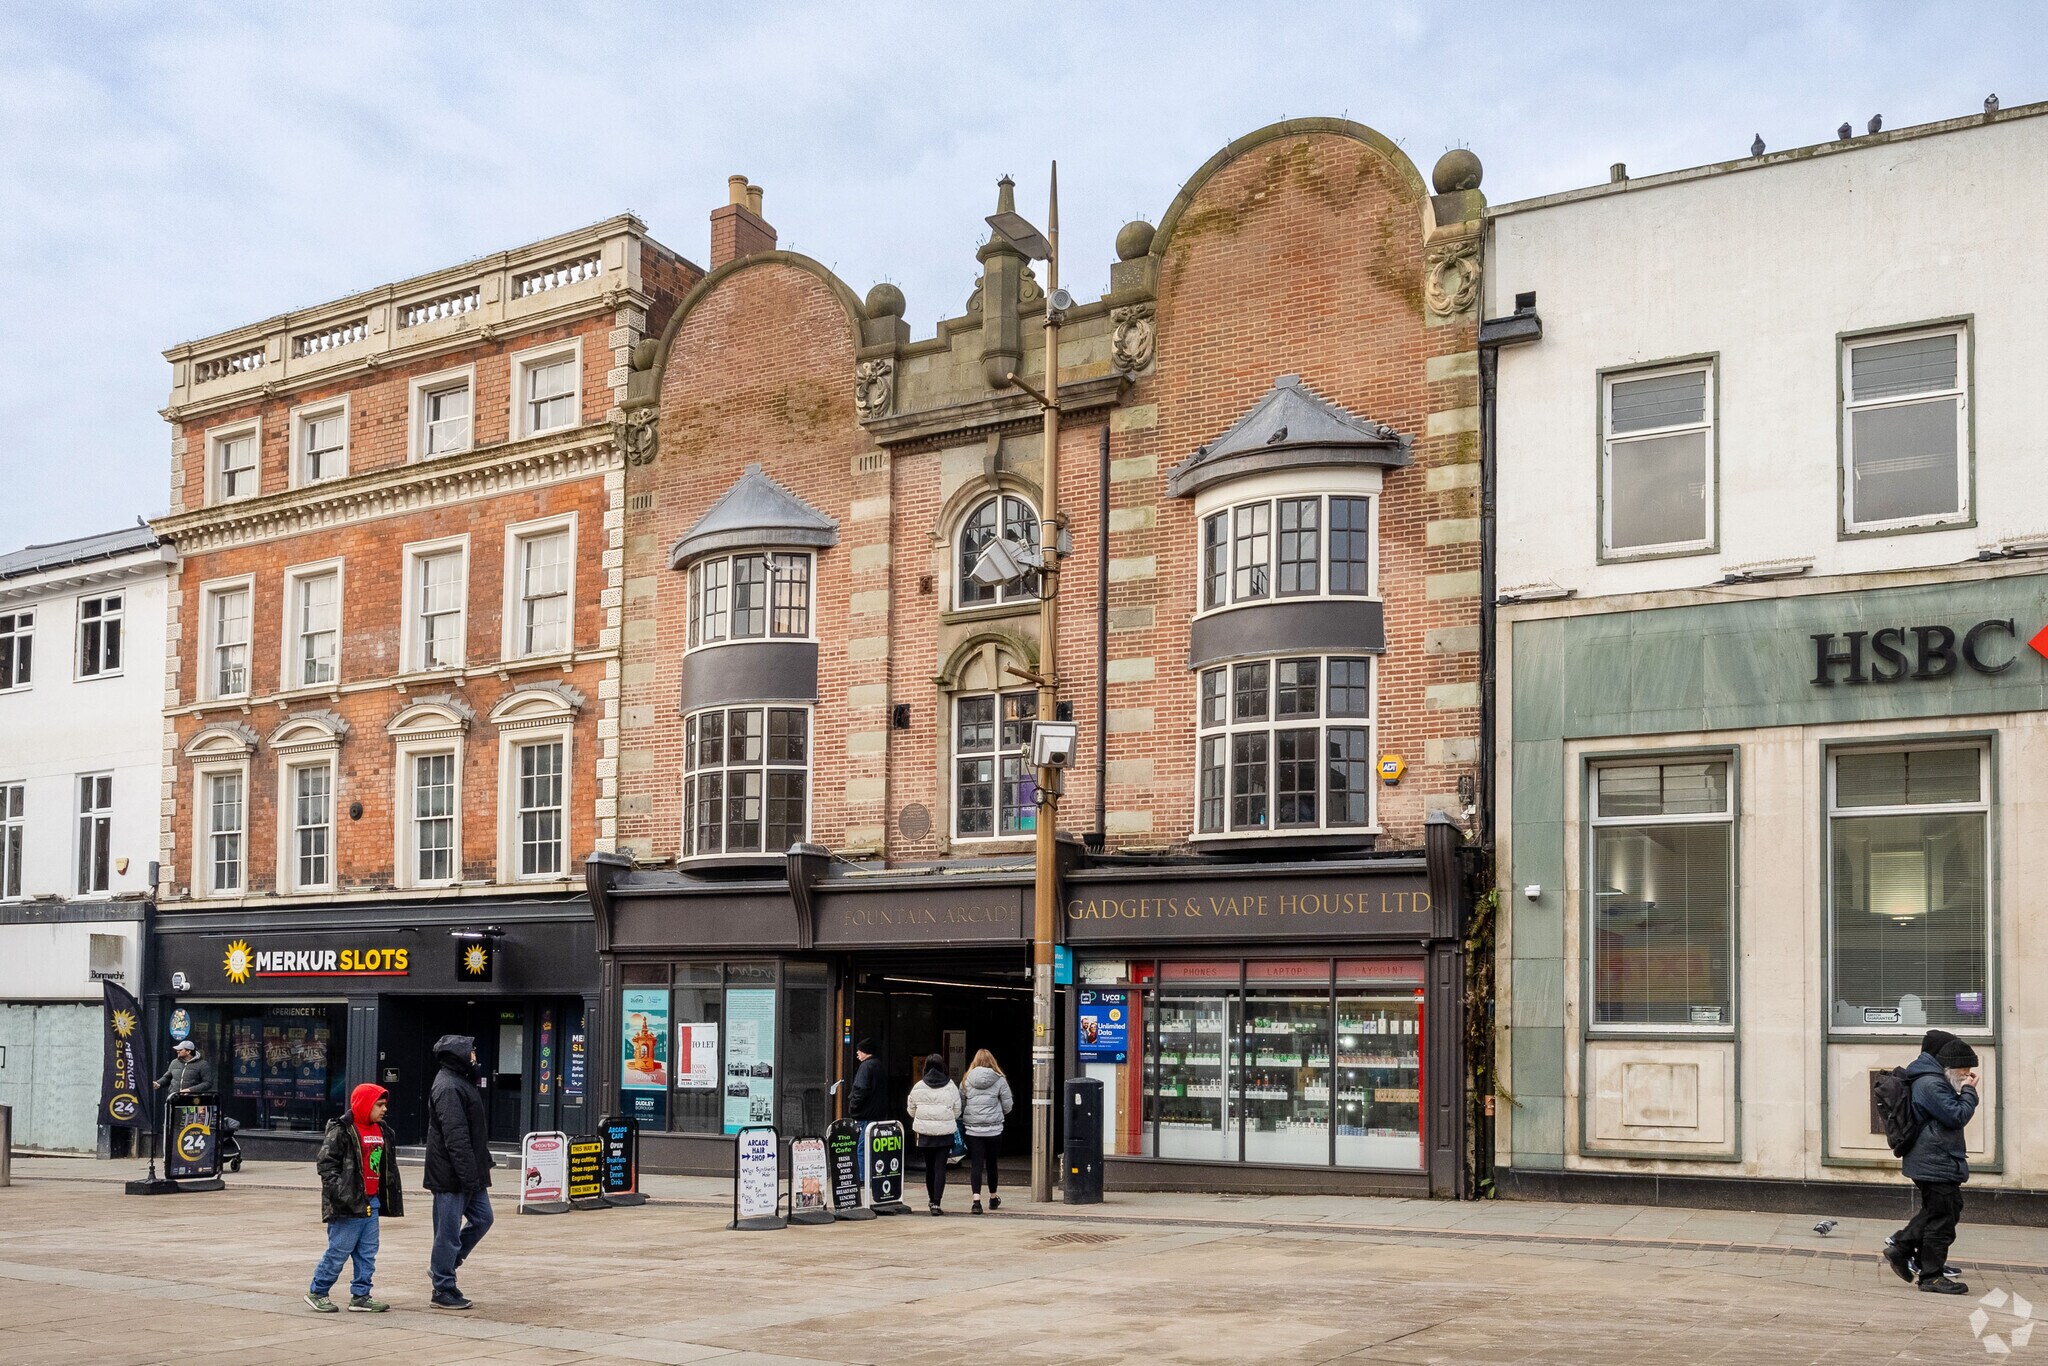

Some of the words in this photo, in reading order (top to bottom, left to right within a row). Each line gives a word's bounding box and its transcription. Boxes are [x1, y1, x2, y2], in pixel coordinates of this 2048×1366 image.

[1810, 618, 2017, 684] HSBC
[1383, 762, 1397, 772] ADT
[1067, 898, 1178, 920] GADGETS
[1184, 896, 1203, 917] &
[1209, 895, 1268, 917] VAPE
[1279, 893, 1369, 915] HOUSE
[1381, 891, 1431, 913] LTD
[845, 908, 936, 926] FOUNTAIN
[943, 904, 1017, 923] ARCADE
[255, 950, 337, 971] MERKUR
[339, 948, 408, 970] SLOTS
[91, 969, 124, 980] Bonmarché
[1183, 968, 1217, 976] PHONES
[1267, 967, 1308, 976] LAPTOPS
[1102, 993, 1120, 1002] Lyca
[702, 1040, 714, 1048] LET
[115, 1039, 125, 1089] SLOTS
[125, 1042, 136, 1090] MERKUR
[114, 1102, 135, 1113] 24
[183, 1135, 206, 1151] 24
[831, 1140, 857, 1148] Arcade
[873, 1136, 901, 1153] OPEN
